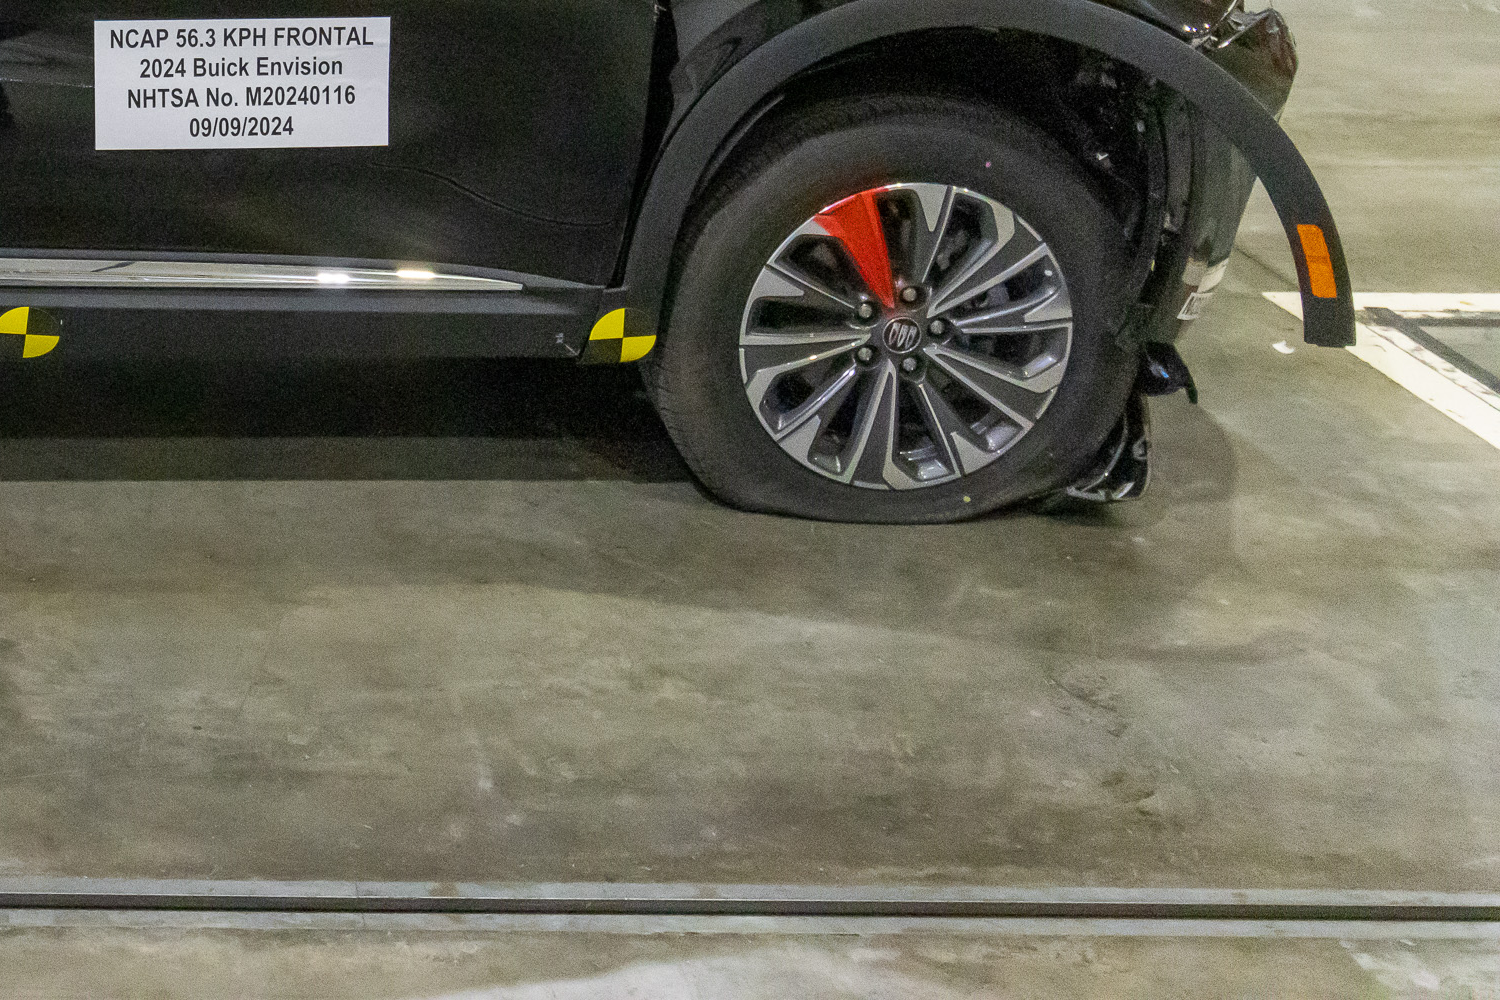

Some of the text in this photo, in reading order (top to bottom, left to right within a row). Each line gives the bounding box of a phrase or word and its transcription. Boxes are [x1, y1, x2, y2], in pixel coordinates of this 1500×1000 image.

[110, 26, 374, 48] NCAP 56.3 KPH FRONTAL
[140, 56, 343, 78] 2024 Buick Envision
[127, 85, 356, 109] NHTSA No. M20240116
[189, 116, 294, 137] 09/09/2024
